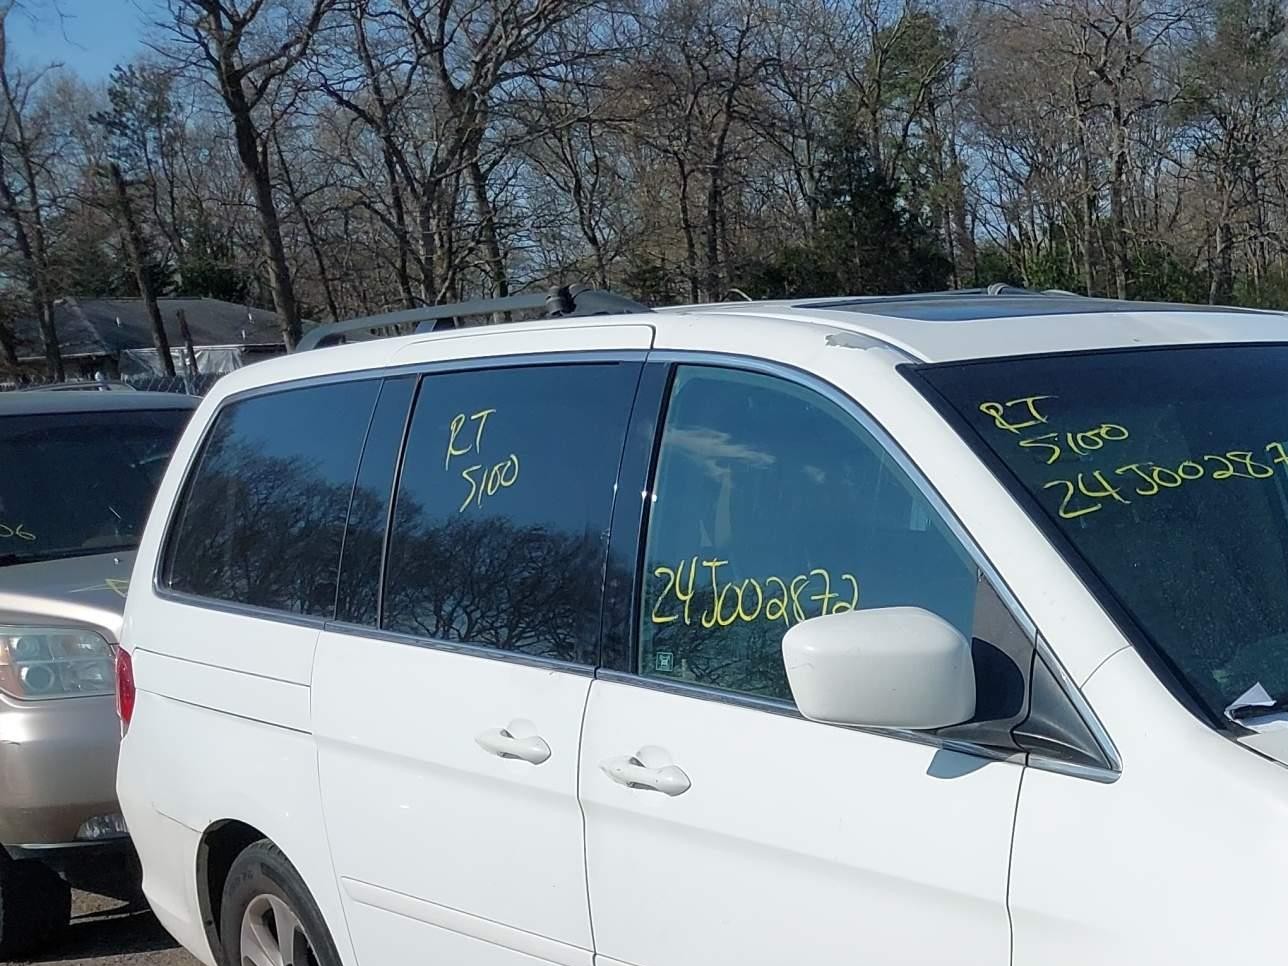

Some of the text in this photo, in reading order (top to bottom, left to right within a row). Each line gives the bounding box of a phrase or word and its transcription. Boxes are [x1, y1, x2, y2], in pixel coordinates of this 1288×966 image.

[445, 408, 497, 471] RT
[979, 396, 1057, 430] RT
[651, 556, 860, 630] 24J002872
